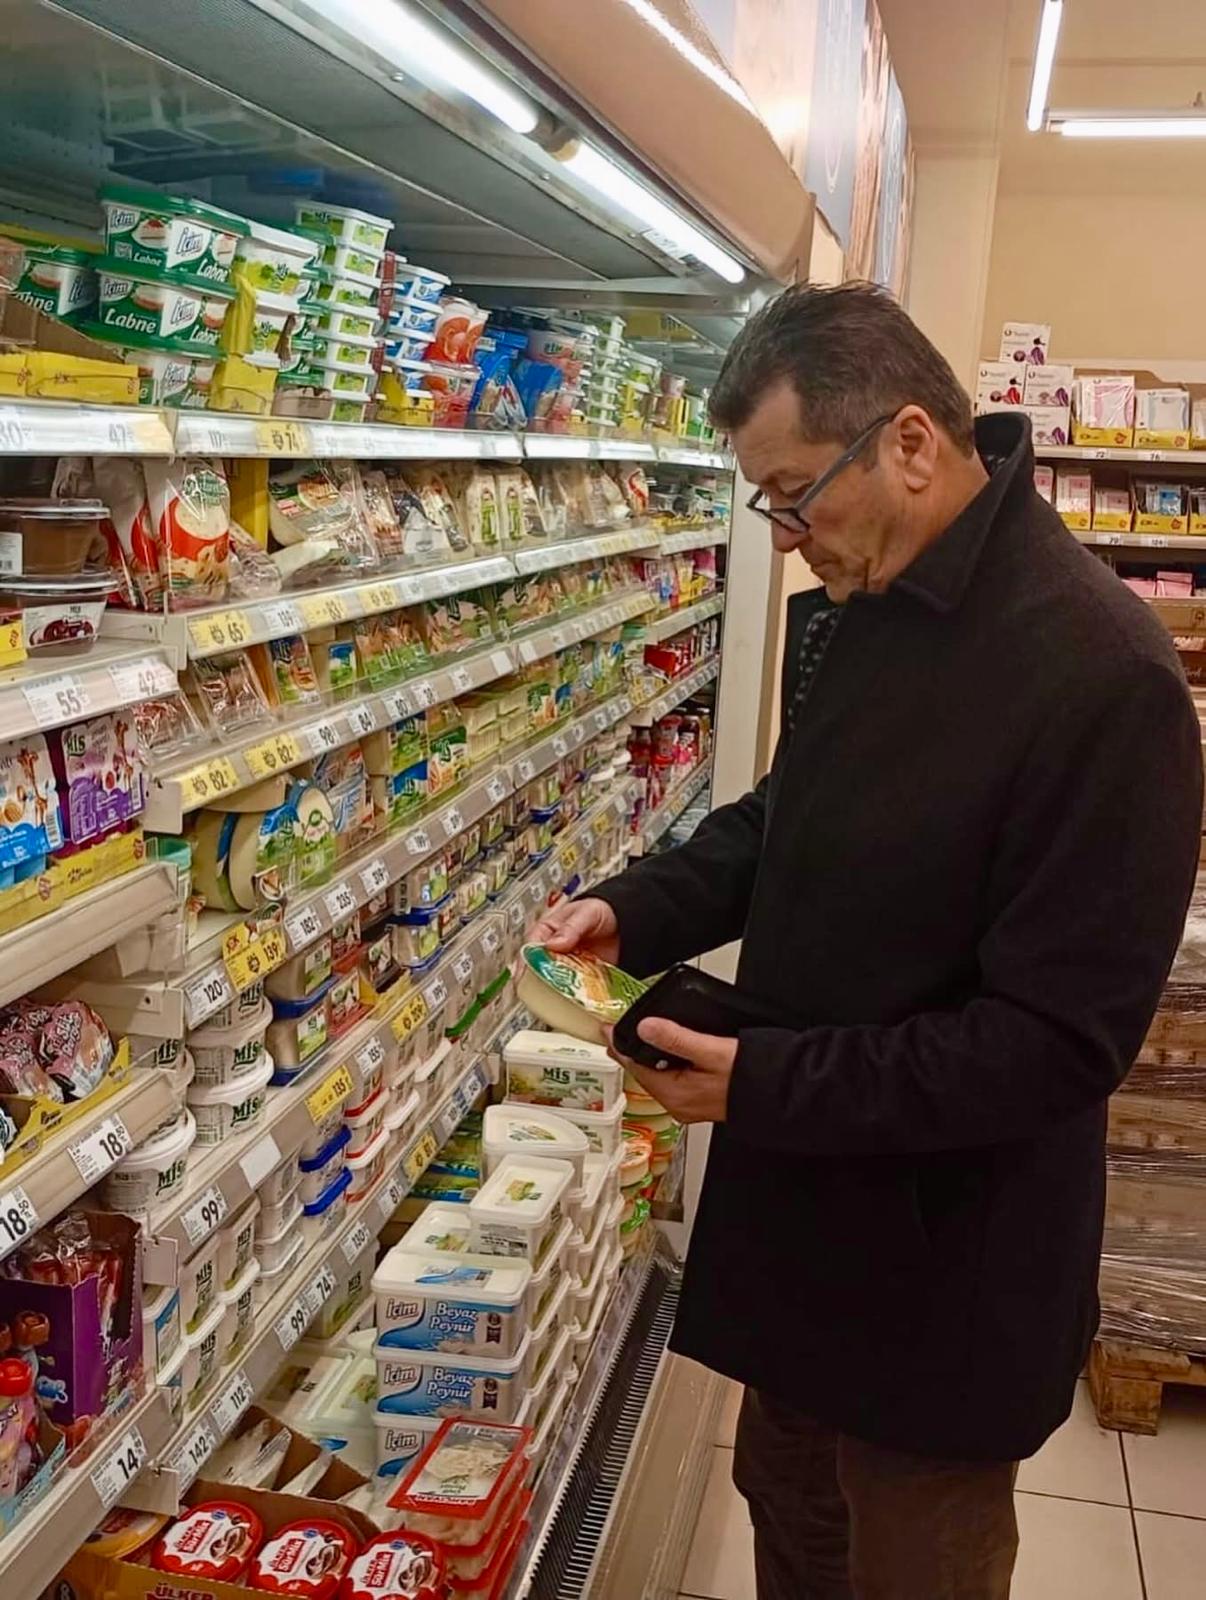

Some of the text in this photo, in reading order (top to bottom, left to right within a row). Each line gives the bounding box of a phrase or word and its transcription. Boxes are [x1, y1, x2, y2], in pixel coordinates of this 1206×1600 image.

[104, 308, 157, 334] Labne
[228, 620, 244, 644] 65
[56, 689, 80, 716] 55
[276, 745, 293, 764] 82
[209, 770, 228, 791] 82
[264, 942, 279, 963] 139
[203, 979, 223, 1004] 120
[99, 1131, 124, 1161] 18
[0, 1207, 27, 1241] 18
[201, 1199, 221, 1228] 99
[316, 1276, 331, 1300] 74
[291, 1308, 306, 1336] 99
[437, 1302, 479, 1321] Beyaz
[429, 1316, 474, 1334] Peynir
[433, 1366, 475, 1386] Beyaz
[230, 1386, 247, 1410] 112
[426, 1381, 470, 1399] Peynir
[188, 1435, 210, 1465] 142
[117, 1448, 139, 1480] 14
